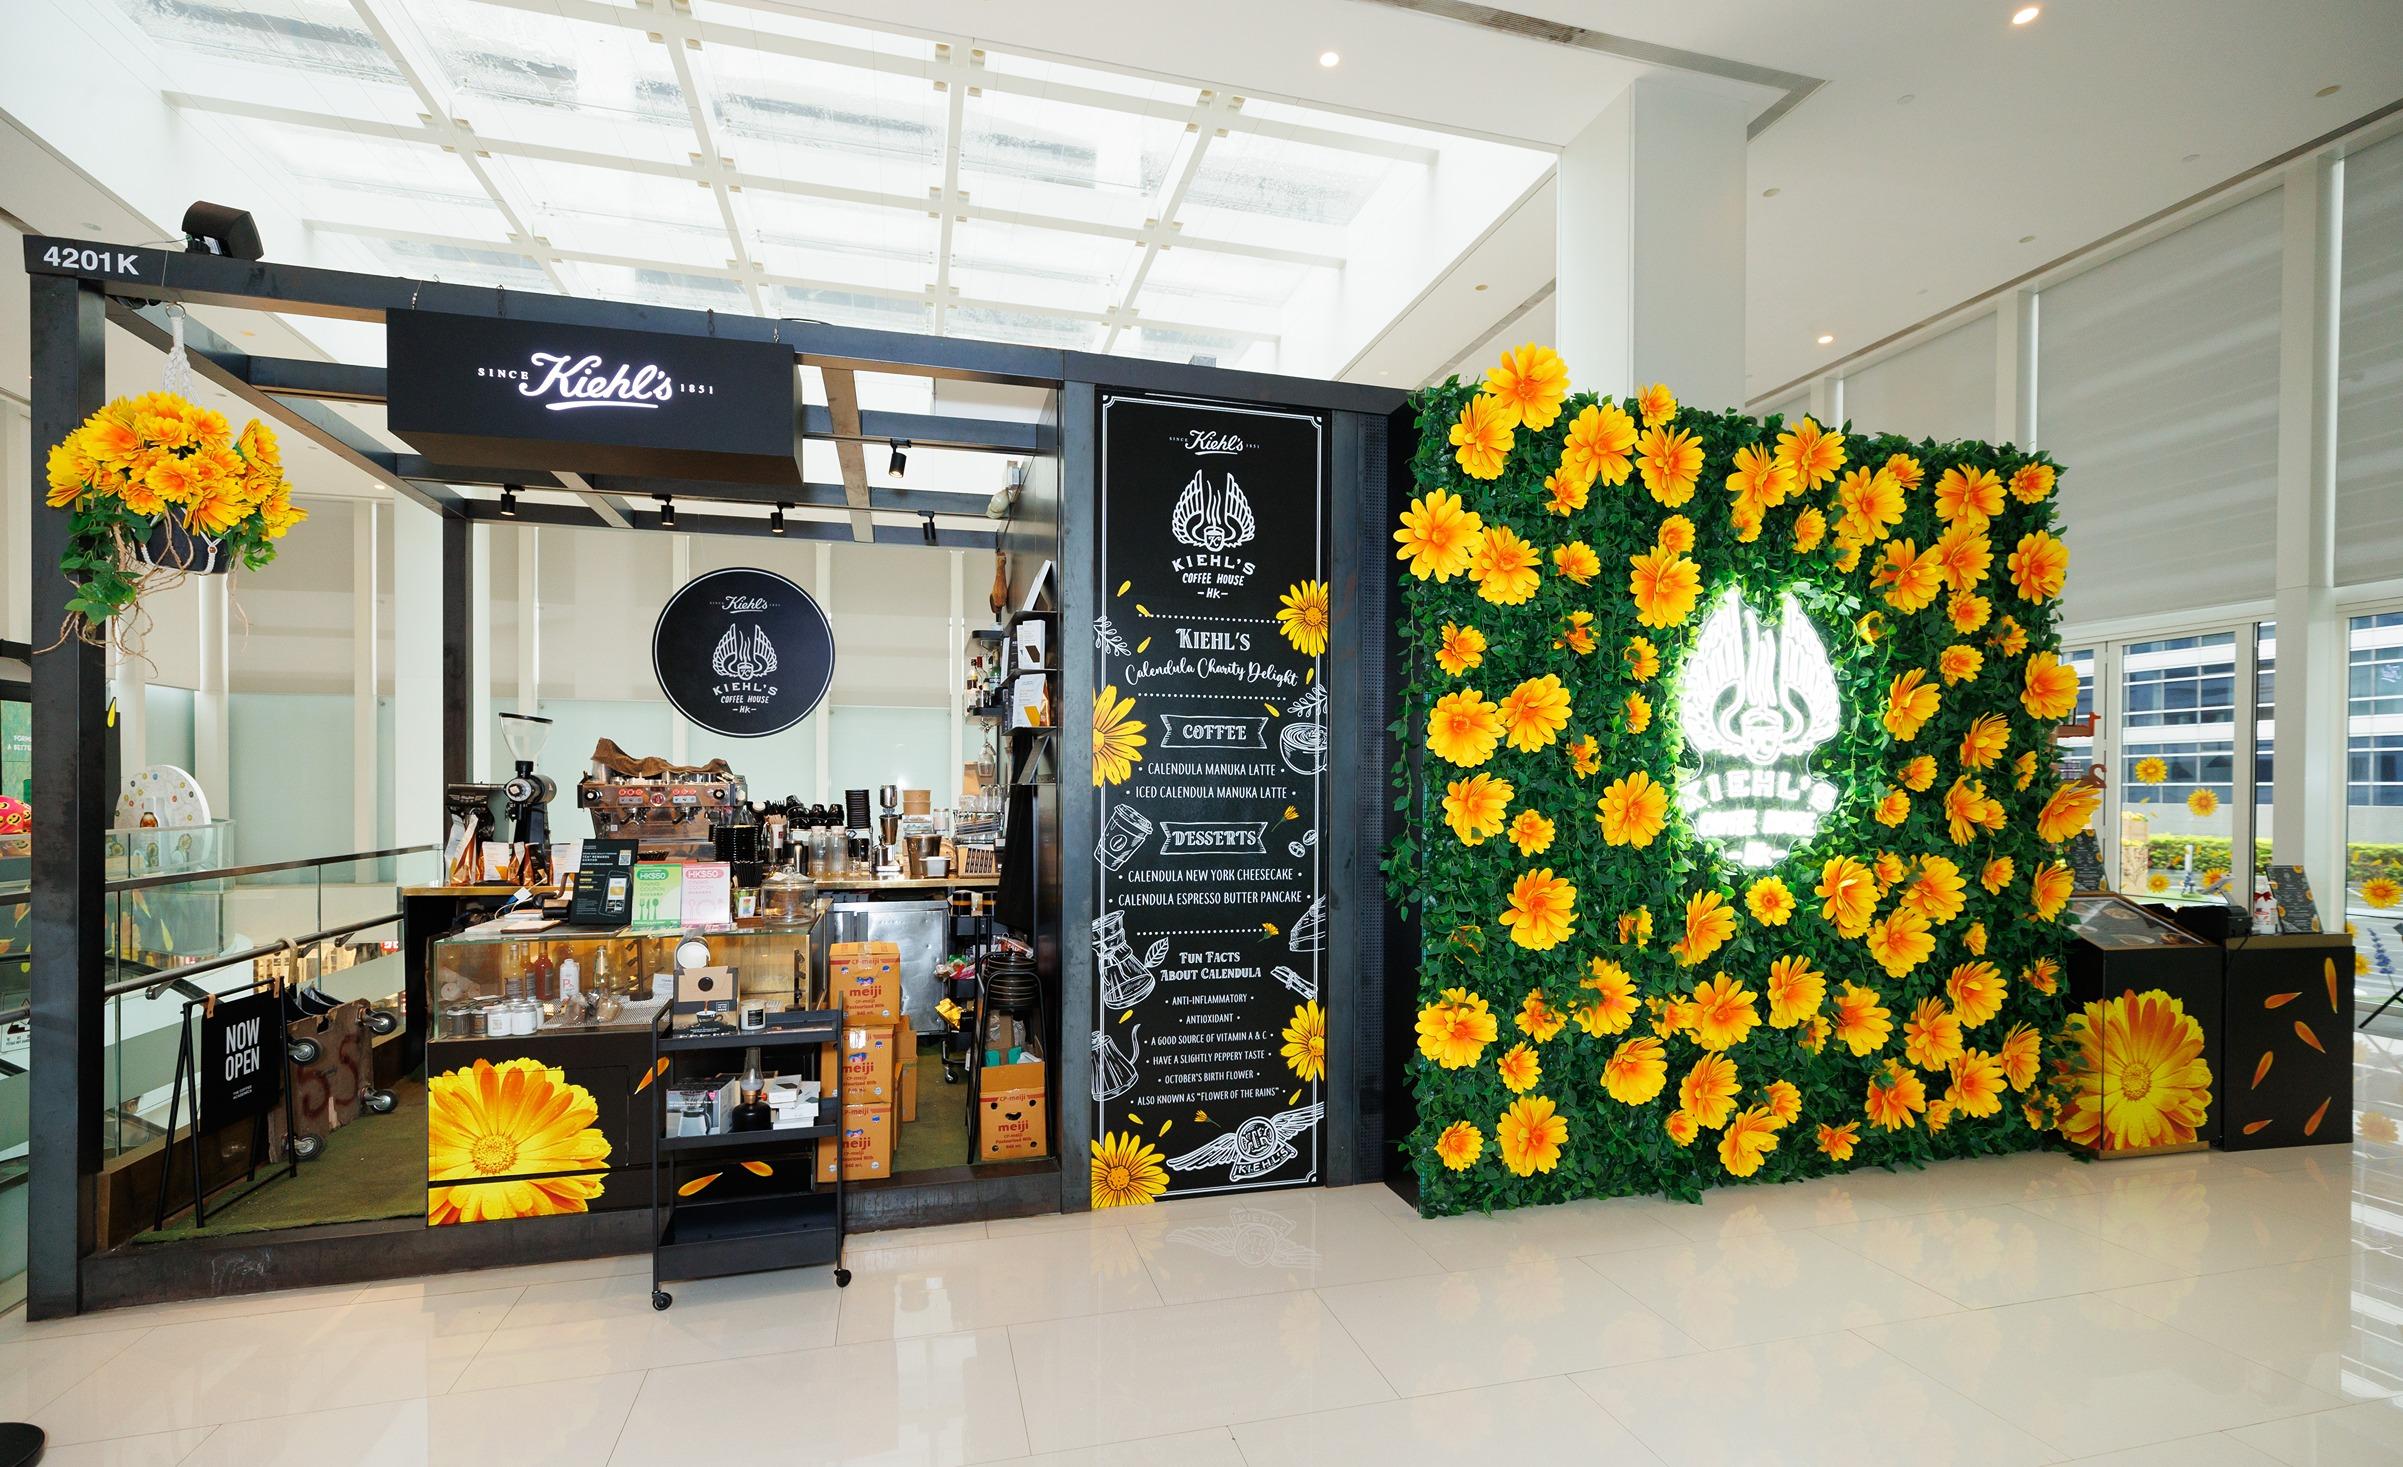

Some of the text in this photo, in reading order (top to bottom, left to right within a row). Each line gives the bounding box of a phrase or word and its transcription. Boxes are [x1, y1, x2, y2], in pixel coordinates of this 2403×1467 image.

[43, 246, 140, 275] 4201K
[477, 352, 714, 401] SINCE Kiehl's 1851
[1185, 430, 1244, 452] Kiehl's
[1171, 554, 1256, 576] KIEHL'S
[1182, 572, 1245, 586] COFFEE HOUSE
[722, 596, 768, 611] Kiehl's
[1175, 628, 1251, 651] KIEHL'S
[1125, 657, 1298, 688] Calendula Charity Delight
[712, 682, 779, 696] KIEHL'S
[720, 695, 770, 704] COFFEE HOUSE
[1182, 724, 1247, 740] COFFEE
[1148, 762, 1276, 776] CALENDULA MANUKA LATTE
[1136, 786, 1287, 799] ICED CALENDULA MANUKA LATTE
[1172, 830, 1258, 846] DESSERTS
[1128, 868, 1294, 883] CALENDULA NEW YORK CHEESECAKE
[1118, 890, 1302, 906] CALENDULA ESPRESSO BUTTER PANCAKE
[1179, 950, 1241, 964] FUN FACTS
[1160, 967, 1262, 982] ABOUT CALENDULA
[849, 985, 882, 998] meiji
[1172, 994, 1248, 1006] ANTI-INFLAMMATORY
[1186, 1013, 1234, 1025] ANTIOXIDANT
[226, 1017, 260, 1055] NOW
[1151, 1031, 1268, 1046] A GOOD SOURCE OF VITAMIN A & C
[225, 1046, 260, 1082] OPEN
[1153, 1050, 1265, 1066] HAVE A SLIGHTLY PEPPERY TASTE
[842, 1062, 874, 1075] meiji
[1164, 1070, 1254, 1084] OCTOBER'S BIRTH FLOWER
[1137, 1086, 1280, 1106] ALSO KNOWN AS "FLOWER OF THE RAINS"
[998, 1120, 1029, 1132] meiji
